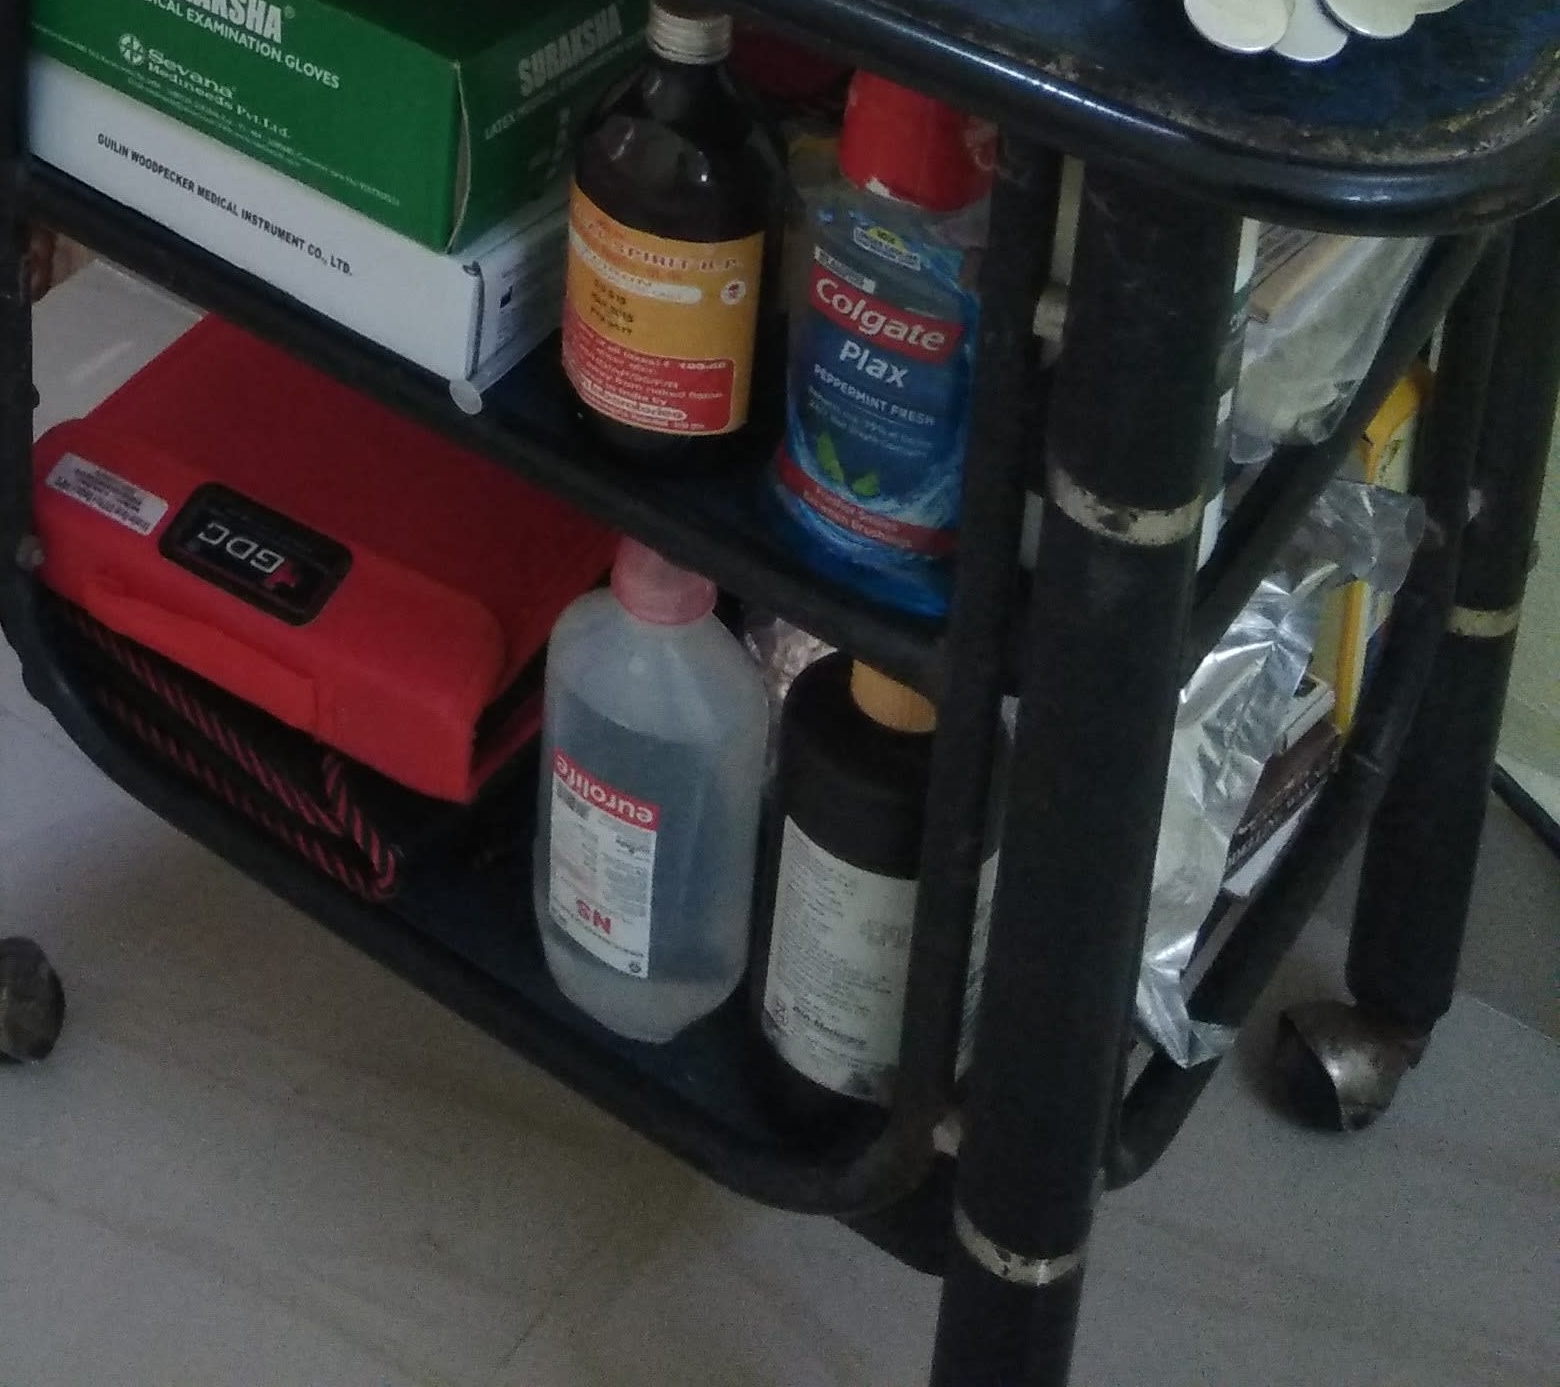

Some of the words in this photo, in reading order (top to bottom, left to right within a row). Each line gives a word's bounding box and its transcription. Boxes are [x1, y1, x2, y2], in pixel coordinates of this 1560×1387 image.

[147, 47, 235, 99] Sevana
[185, 7, 283, 64] EXAMINATION
[283, 53, 342, 90] GLOVES
[517, 2, 623, 98] SURAKSHA
[97, 131, 129, 161] GUILIN
[130, 148, 195, 195] WOODPECKER
[196, 179, 239, 218] MEDICAL
[240, 207, 306, 253] INSTRUMENT
[329, 254, 353, 277] LTD.
[815, 277, 947, 352] Colgate
[813, 363, 889, 413] PEPPERMINT
[890, 404, 937, 427] FRESH
[839, 339, 910, 389] Plax
[197, 521, 286, 574] GDC
